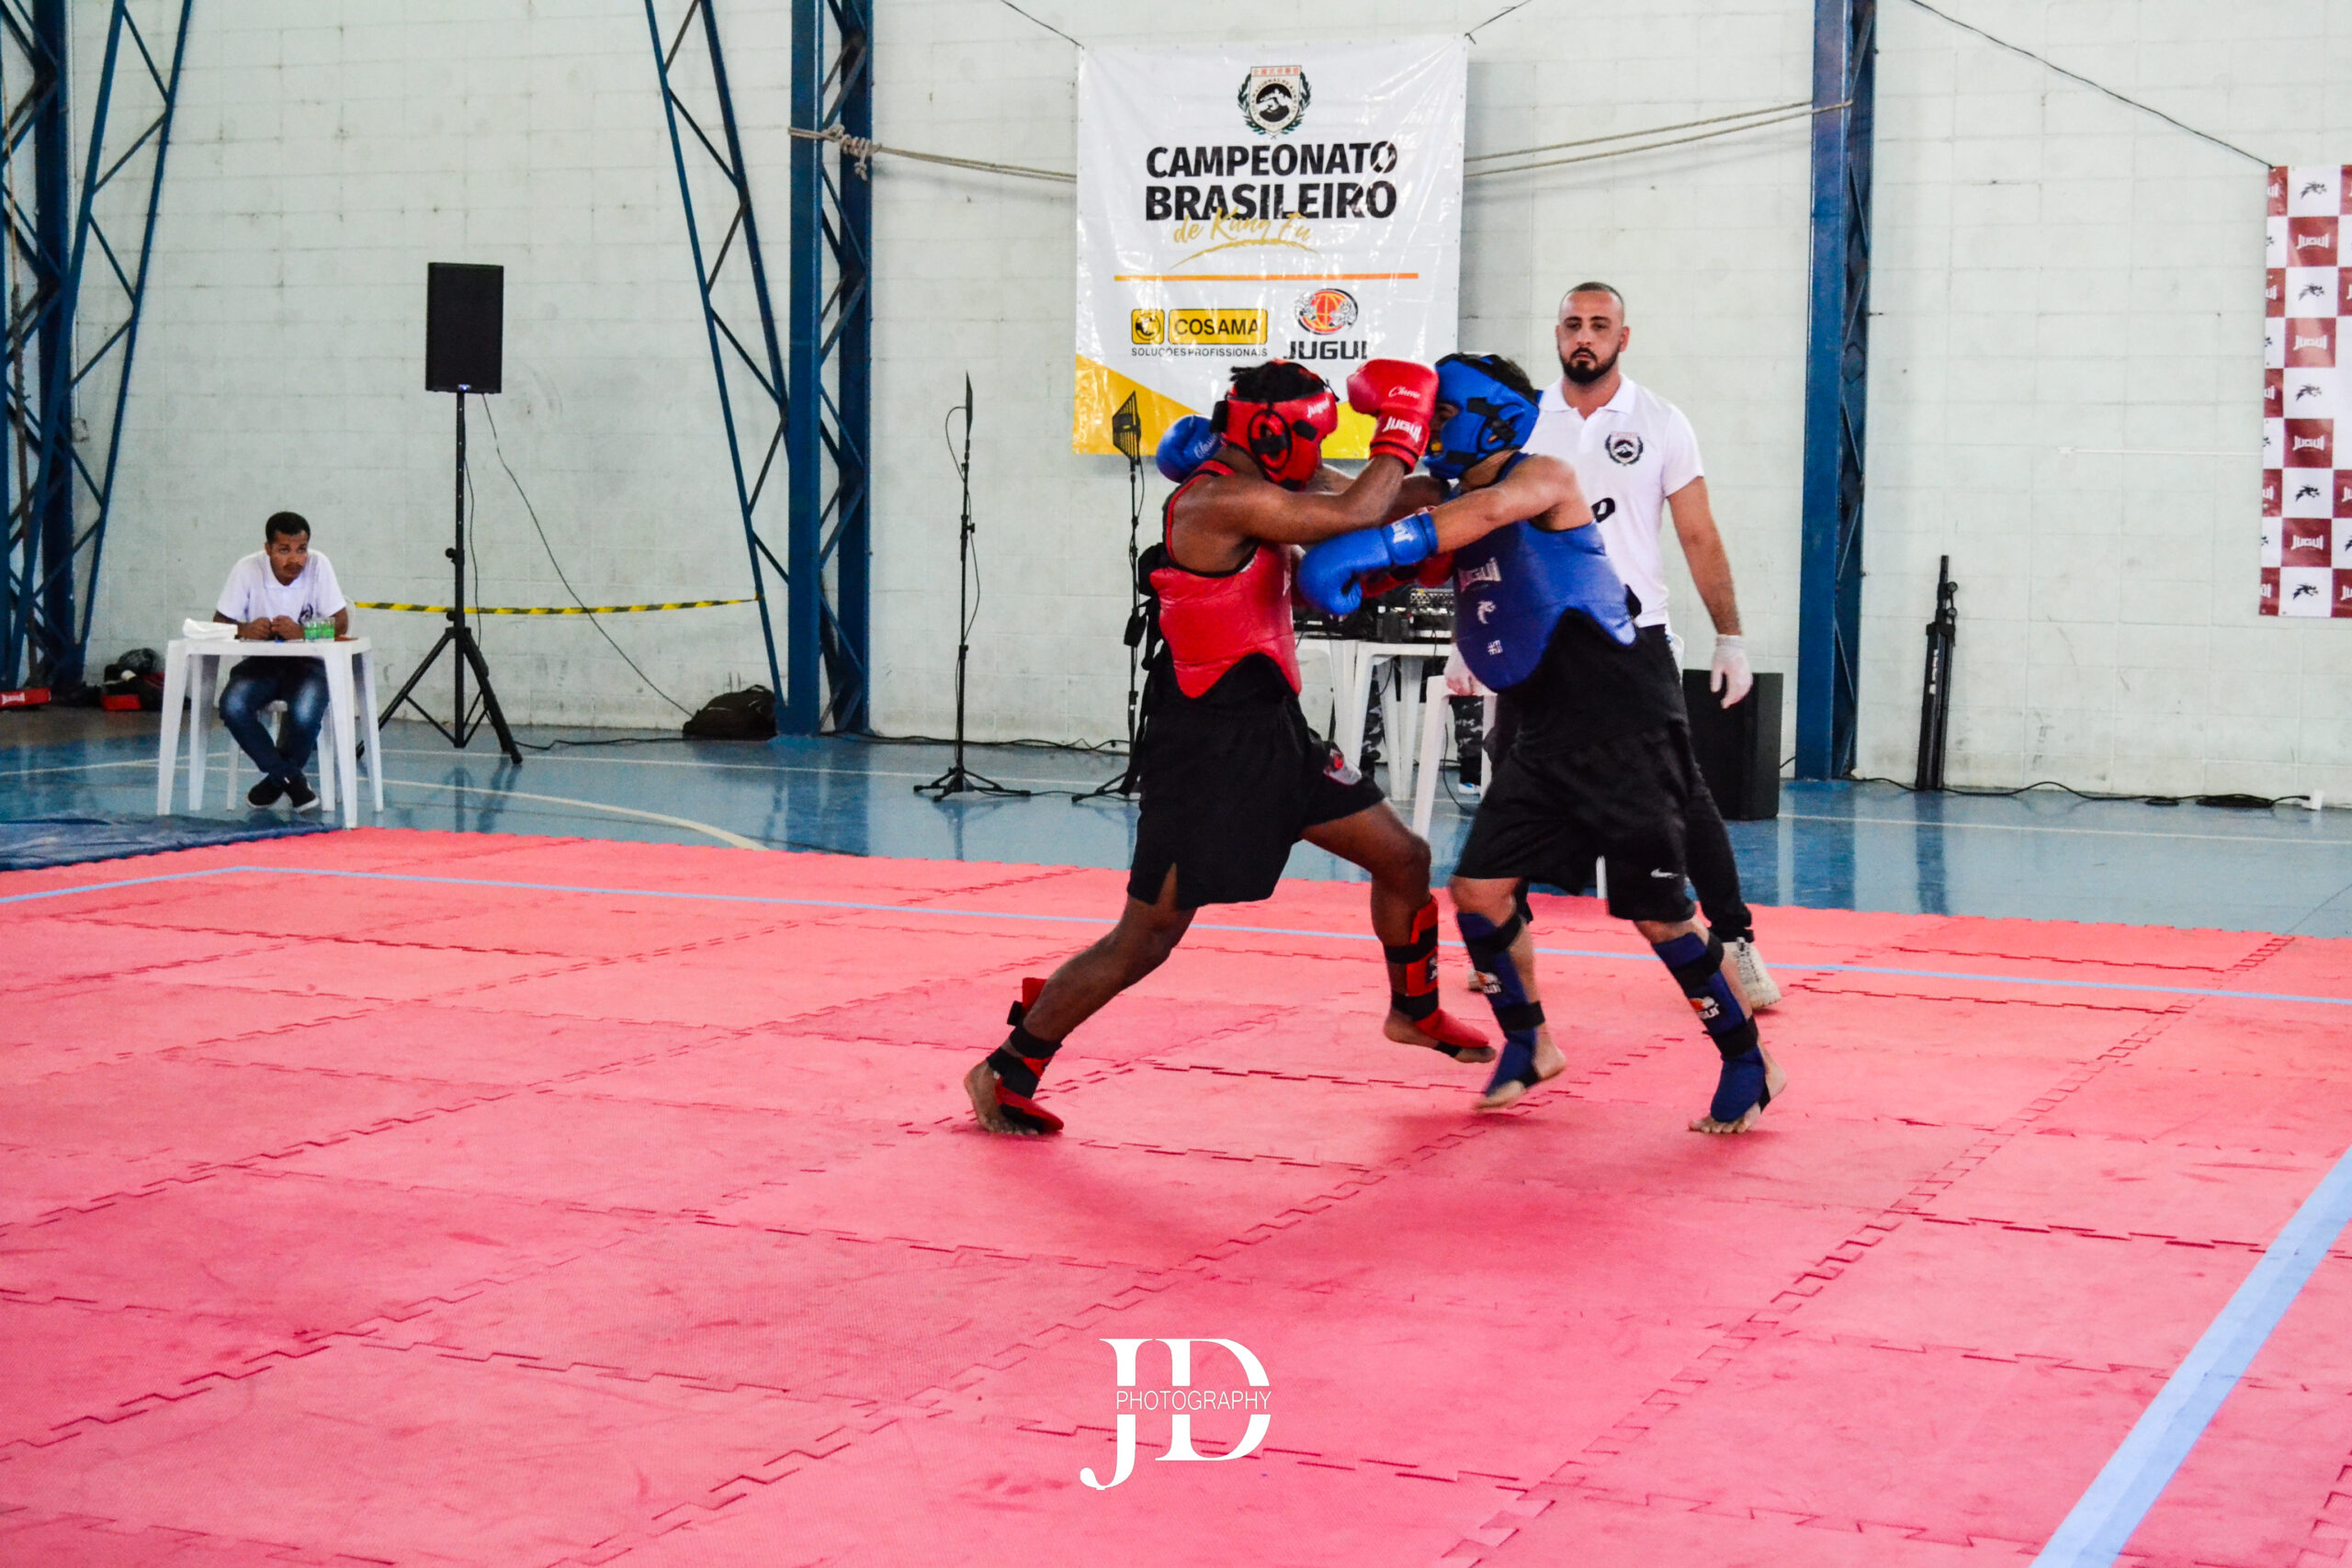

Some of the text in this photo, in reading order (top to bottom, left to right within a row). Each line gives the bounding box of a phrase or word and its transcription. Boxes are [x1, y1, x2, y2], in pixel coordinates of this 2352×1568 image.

[1146, 141, 1398, 178] CAMPEONATO
[1146, 180, 1397, 220] BRASILEIRO
[1173, 206, 1315, 243] de Kung Fu
[1174, 318, 1260, 336] COSAMA
[1188, 347, 1268, 357] PROFISSIONAS
[1283, 340, 1368, 360] JUGUI
